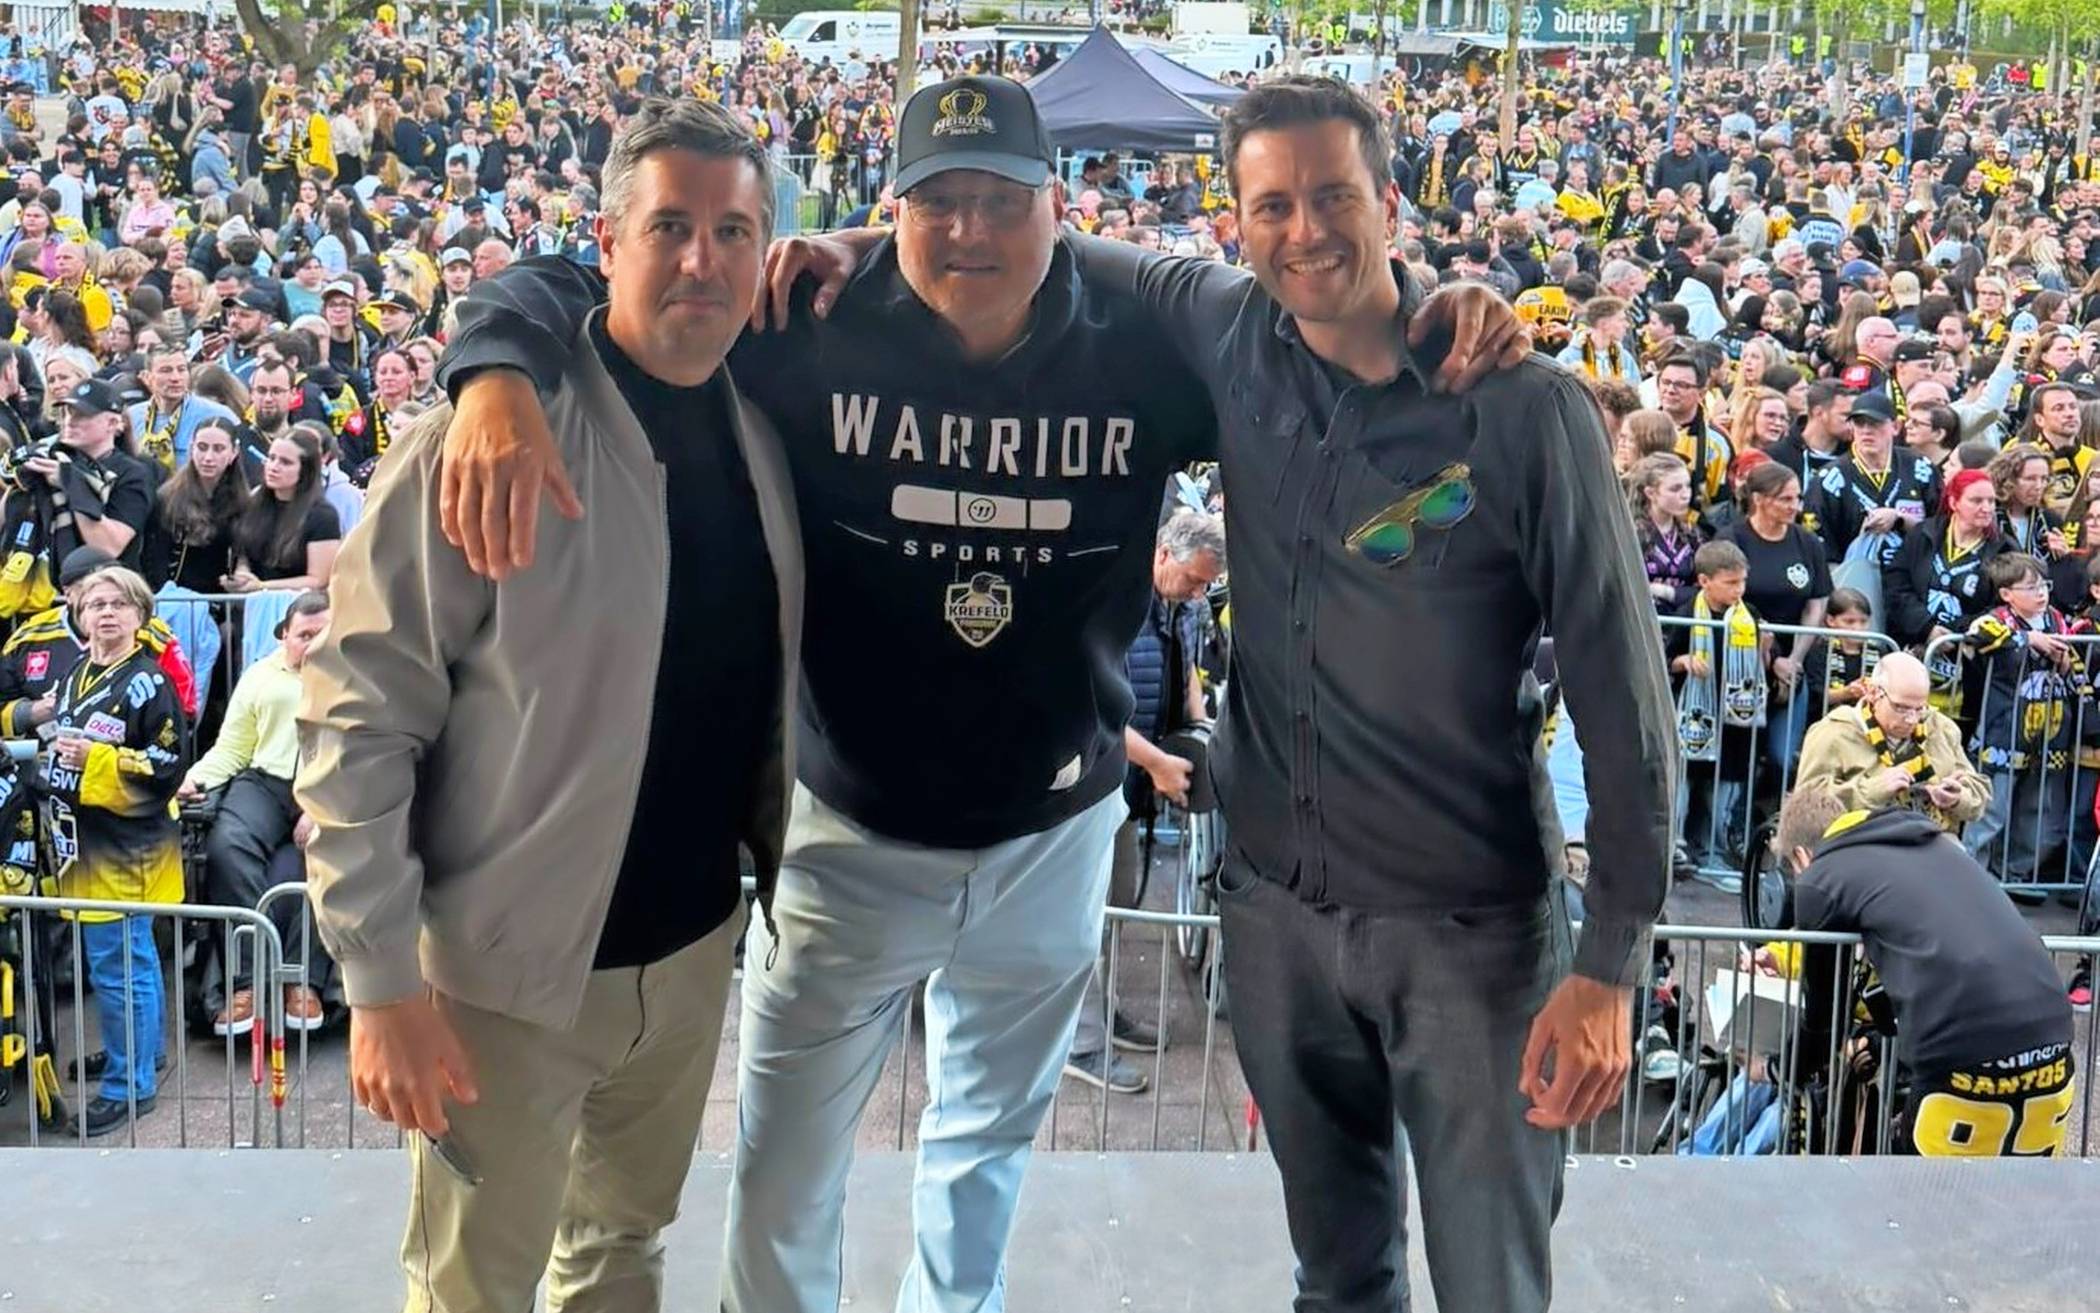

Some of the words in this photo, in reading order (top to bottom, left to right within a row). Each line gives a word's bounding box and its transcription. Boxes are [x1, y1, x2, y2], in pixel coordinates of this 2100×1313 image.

[832, 393, 1134, 478] WARRIOR
[904, 540, 1052, 562] SPORTS
[948, 605, 1009, 618] KREFELD
[1951, 1057, 2067, 1094] SANTOS
